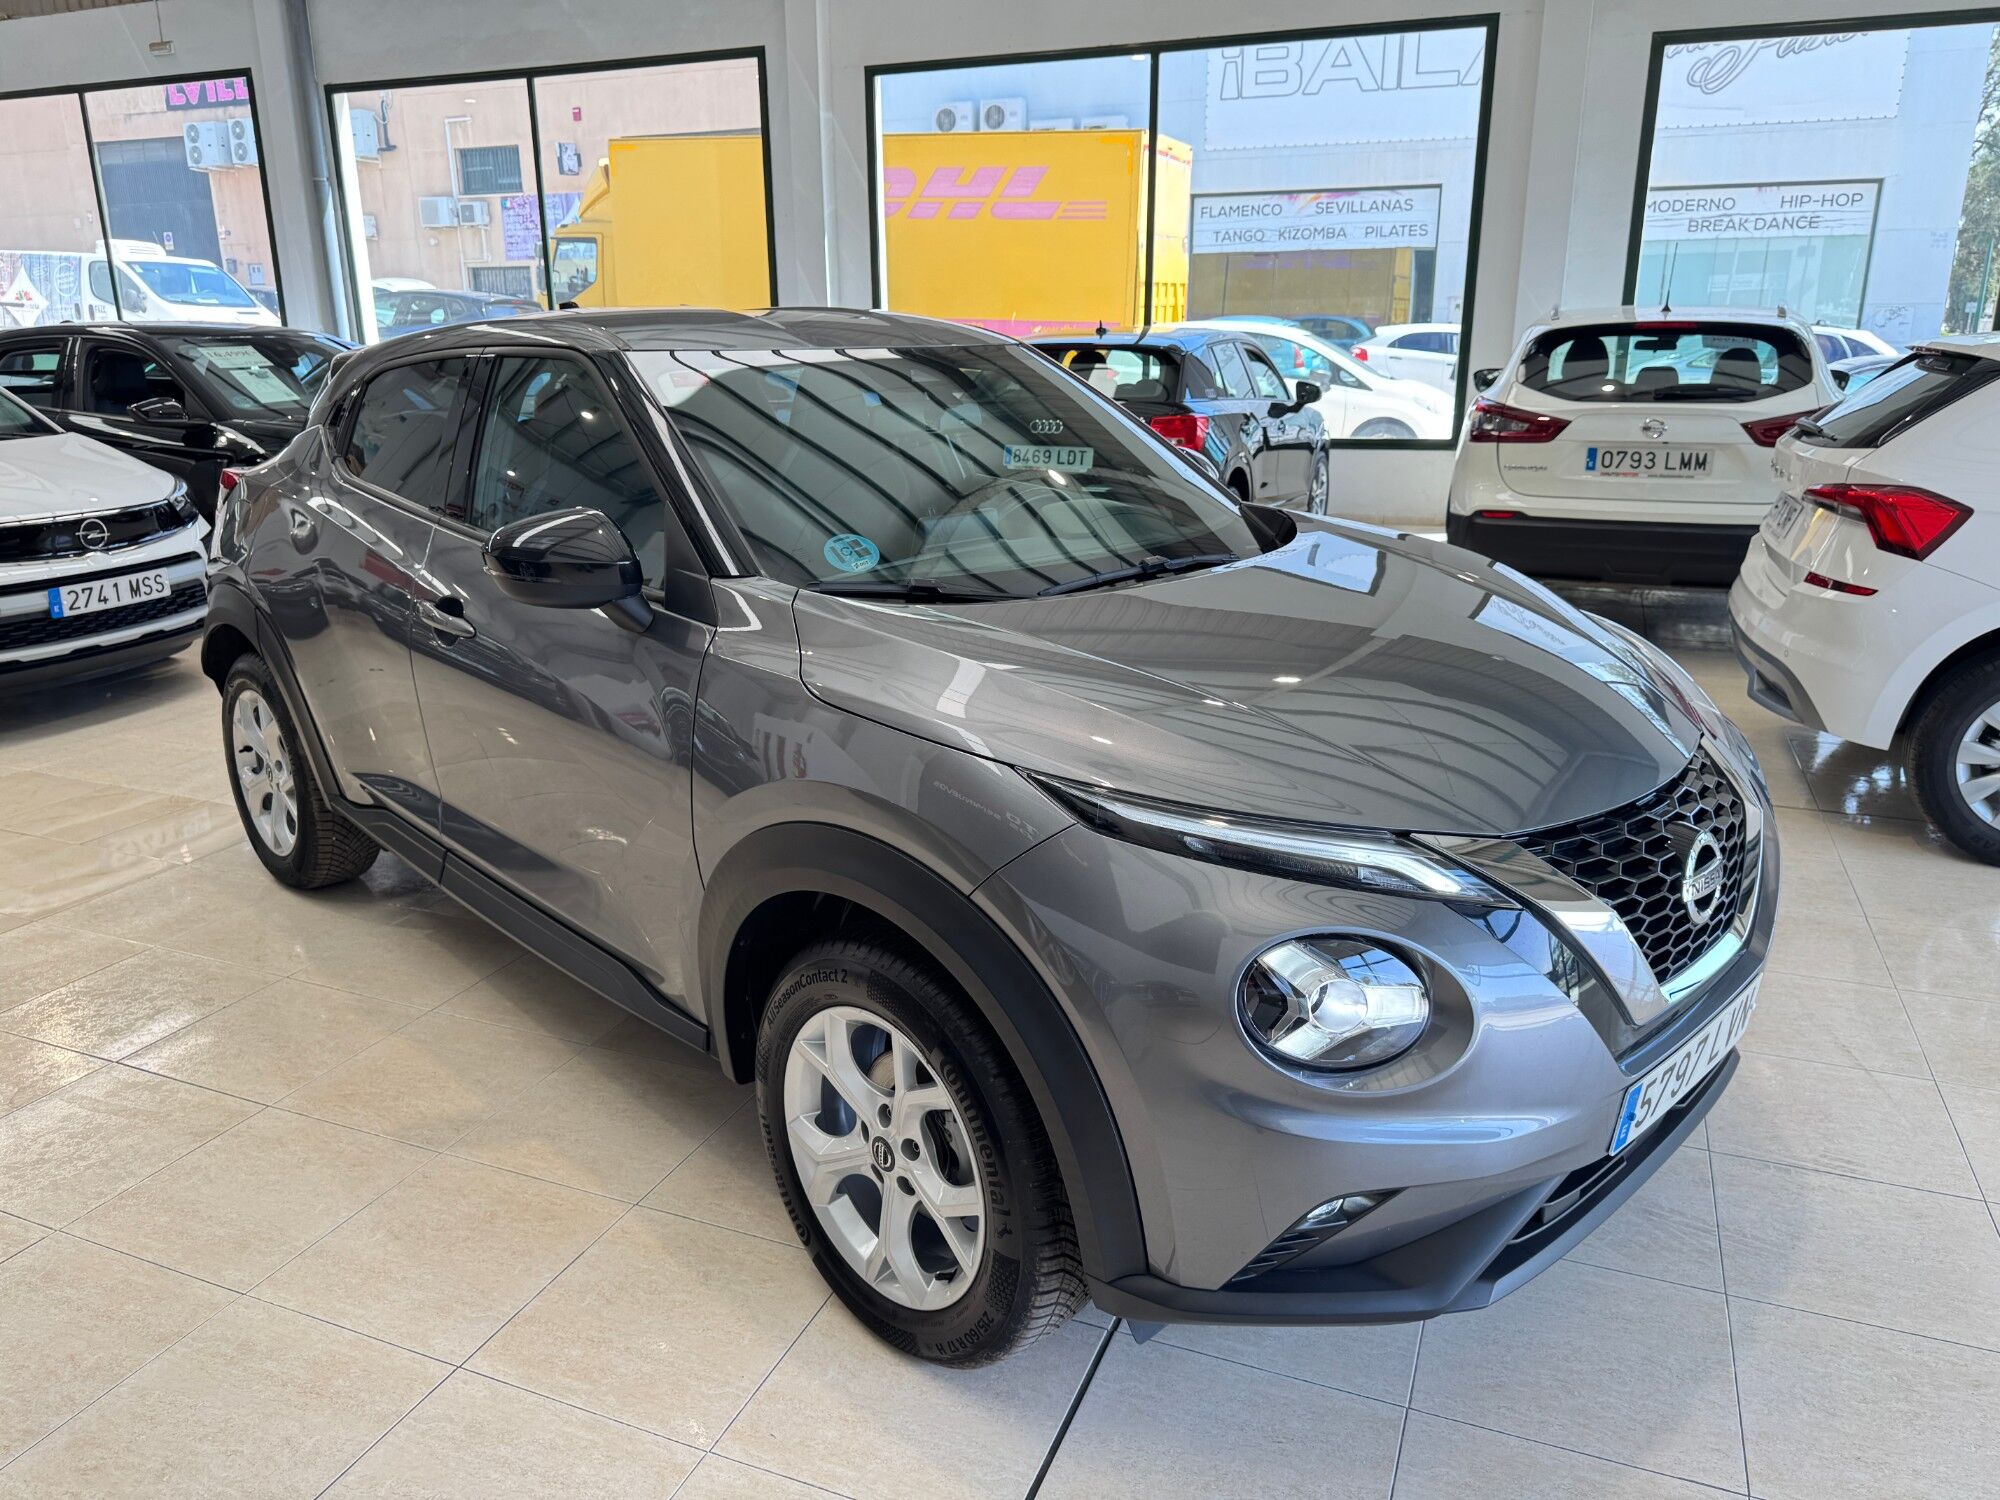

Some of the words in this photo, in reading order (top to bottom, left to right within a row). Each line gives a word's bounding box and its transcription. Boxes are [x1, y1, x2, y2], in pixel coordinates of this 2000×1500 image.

[1220, 33, 1484, 101] ¡BAIL
[1200, 203, 1283, 219] FLAMENCO
[1315, 198, 1414, 215] SEVILLANAS
[1780, 192, 1864, 209] HIP-HOP
[1213, 229, 1265, 243] TANGO
[1278, 226, 1347, 241] KIZOMBA
[1364, 223, 1428, 239] PILATES
[1013, 448, 1052, 465] 8469
[1056, 449, 1088, 466] LDT
[1601, 450, 1657, 470] 0793
[1664, 451, 1708, 471] LMM
[67, 582, 121, 611] 2741
[128, 574, 165, 599] MSS
[840, 968, 848, 984] 2
[1634, 1033, 1710, 1129] 5797
